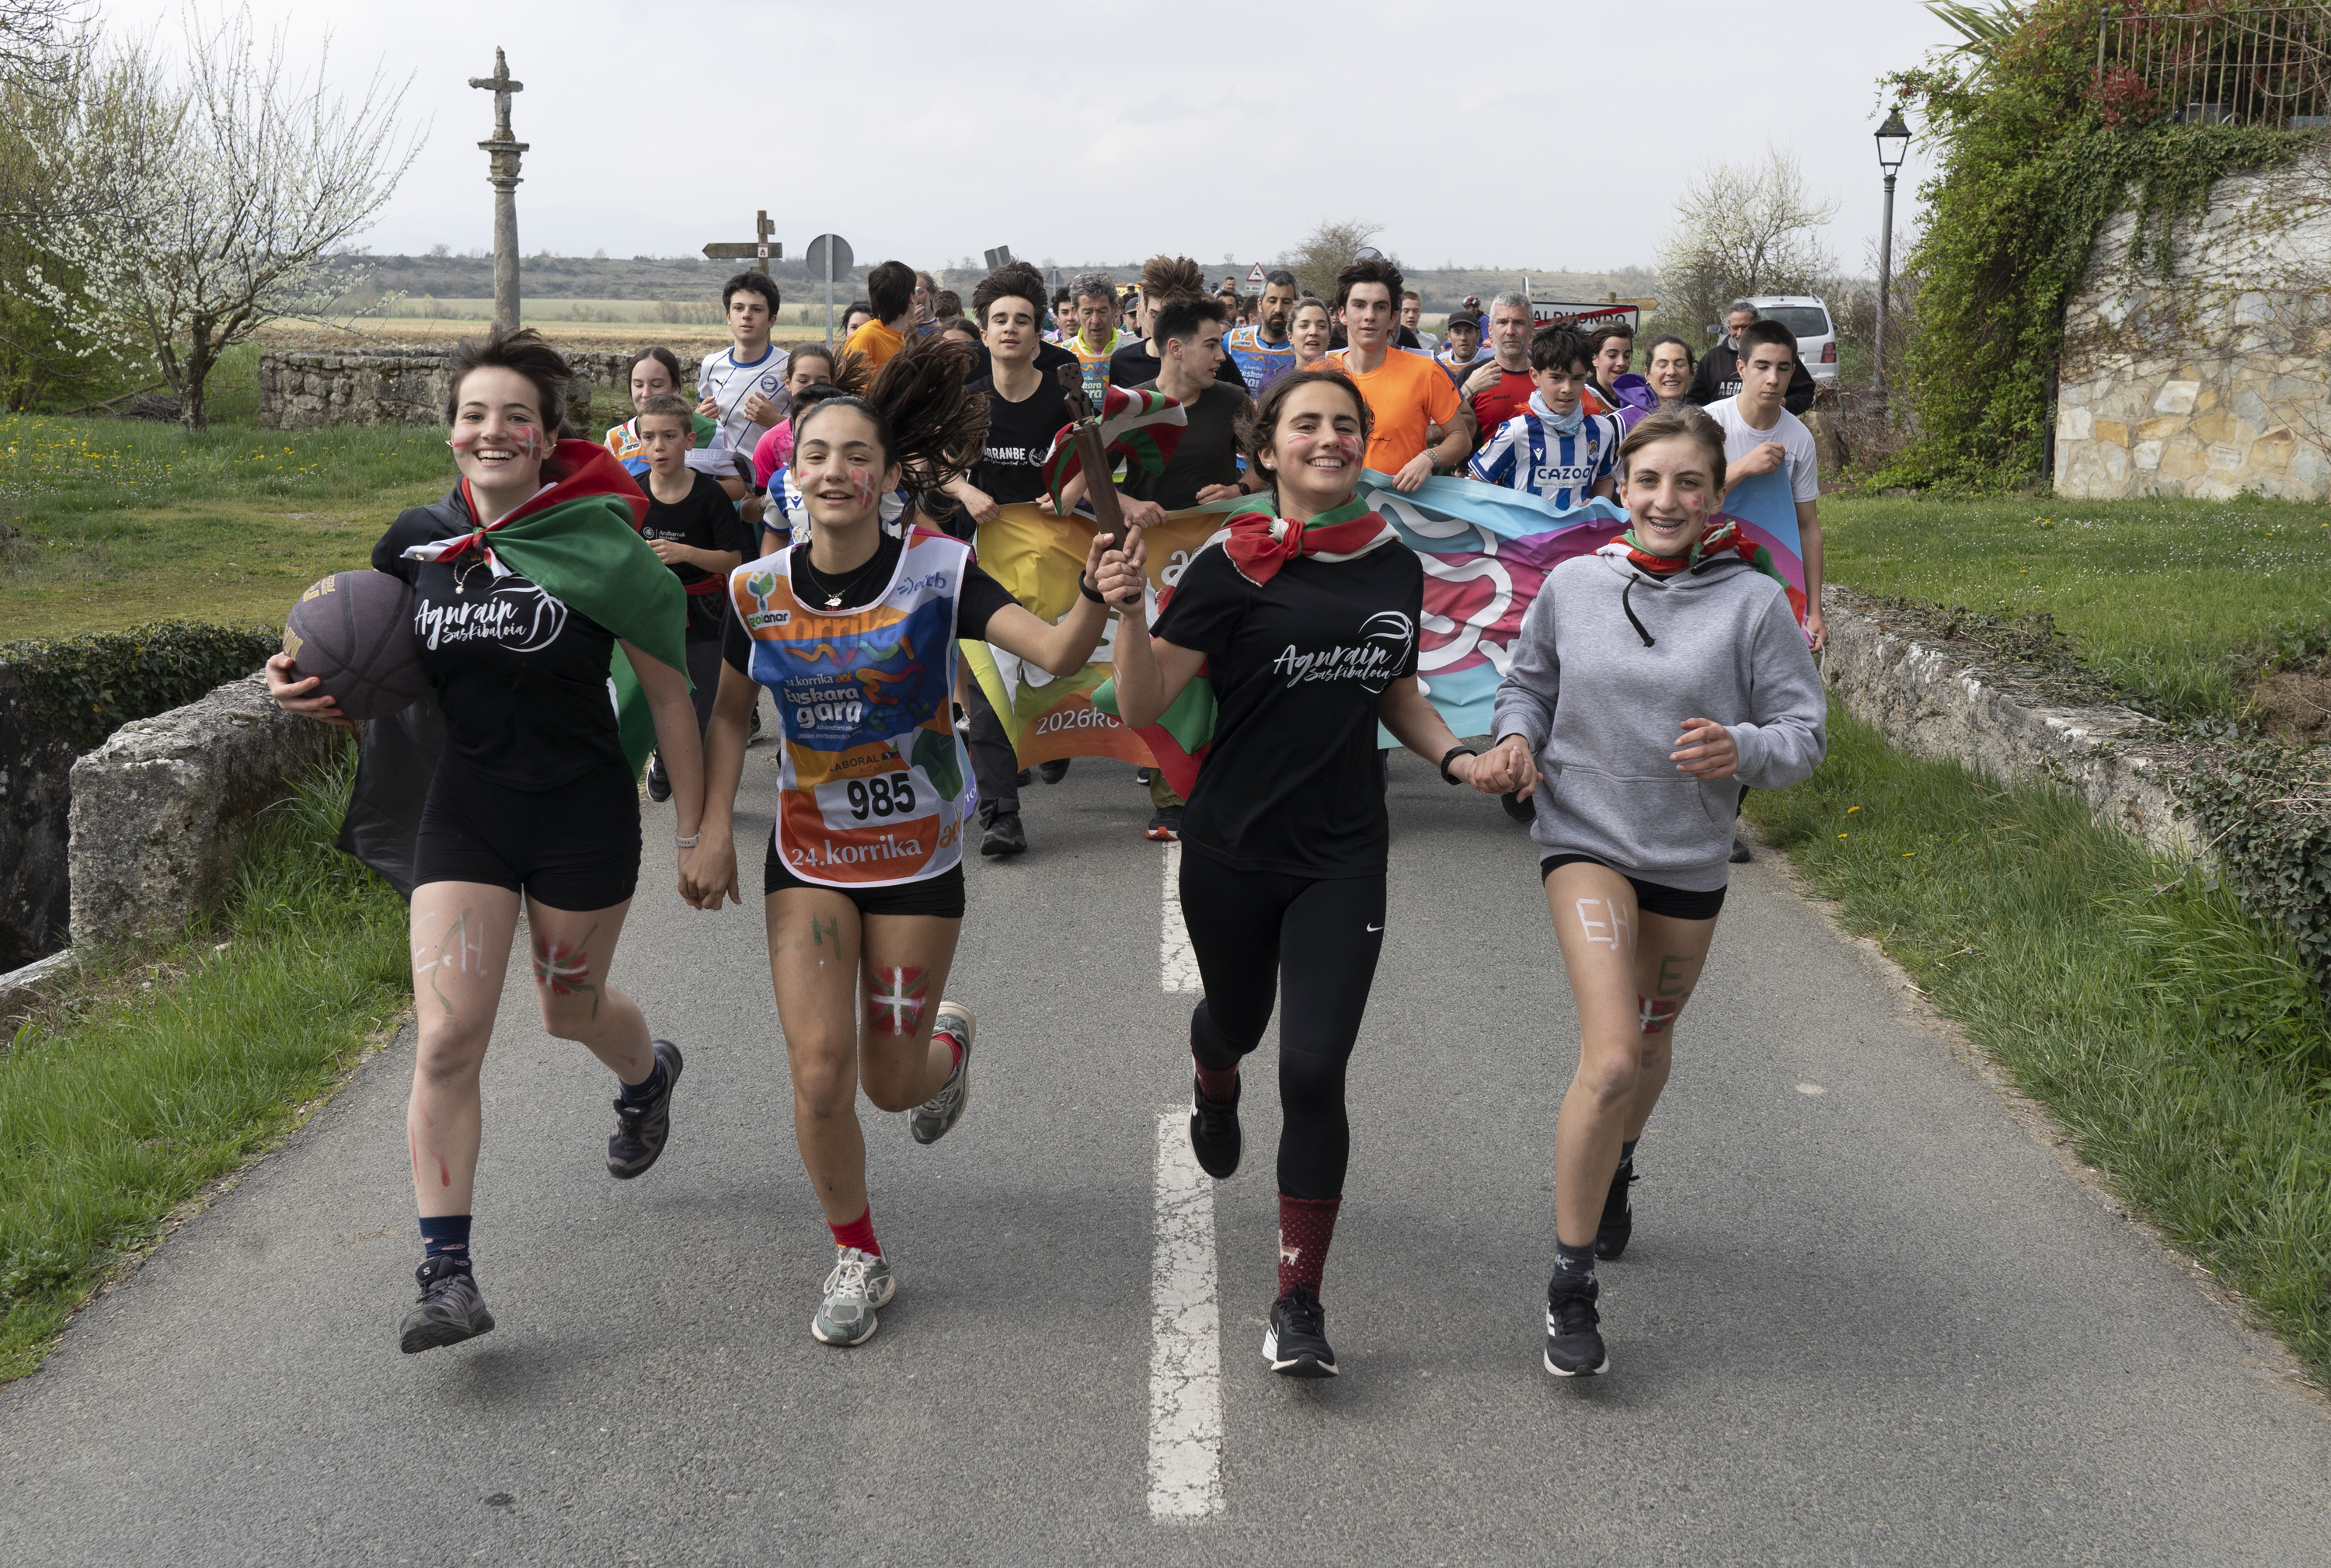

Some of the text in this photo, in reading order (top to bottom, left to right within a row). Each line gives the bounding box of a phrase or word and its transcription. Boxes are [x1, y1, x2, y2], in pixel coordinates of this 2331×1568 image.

[1534, 310, 1626, 325] ALDONDO
[1082, 381, 1102, 389] kara
[1717, 382, 1743, 395] AGU
[1537, 467, 1591, 480] CAZOO
[414, 596, 519, 650] Agurain
[748, 612, 789, 628] goiener
[793, 611, 902, 648] orrika
[1274, 642, 1392, 688] Agurain
[784, 670, 853, 687] 24.korrika aek
[783, 687, 859, 705] Euskara
[796, 701, 862, 729] gara
[829, 754, 880, 772] LABORAL
[859, 764, 883, 773] kutxa
[846, 772, 916, 821] 985
[791, 834, 923, 867] 24.korrika
